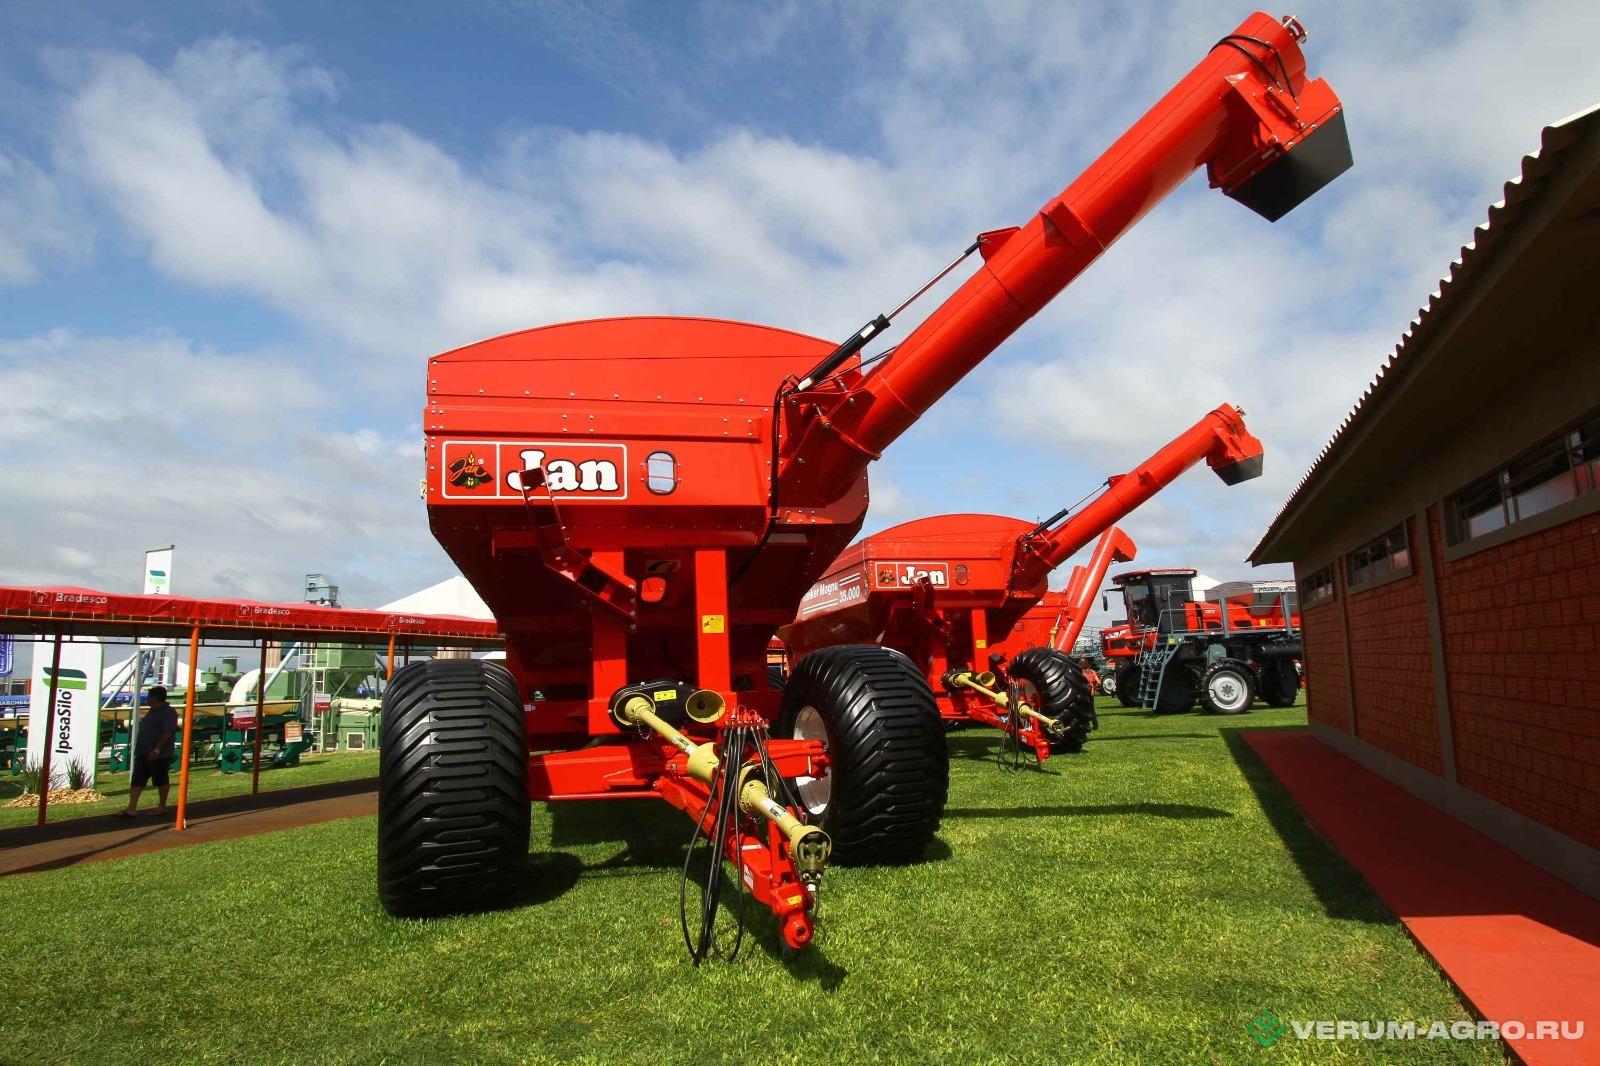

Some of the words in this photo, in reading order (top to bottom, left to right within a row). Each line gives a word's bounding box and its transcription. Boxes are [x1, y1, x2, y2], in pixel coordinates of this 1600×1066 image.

[507, 450, 619, 492] Jan
[55, 592, 108, 604] Bradesco
[254, 606, 290, 616] Bradesco
[398, 616, 426, 625] Bradesco
[55, 690, 73, 754] IpesaSilo
